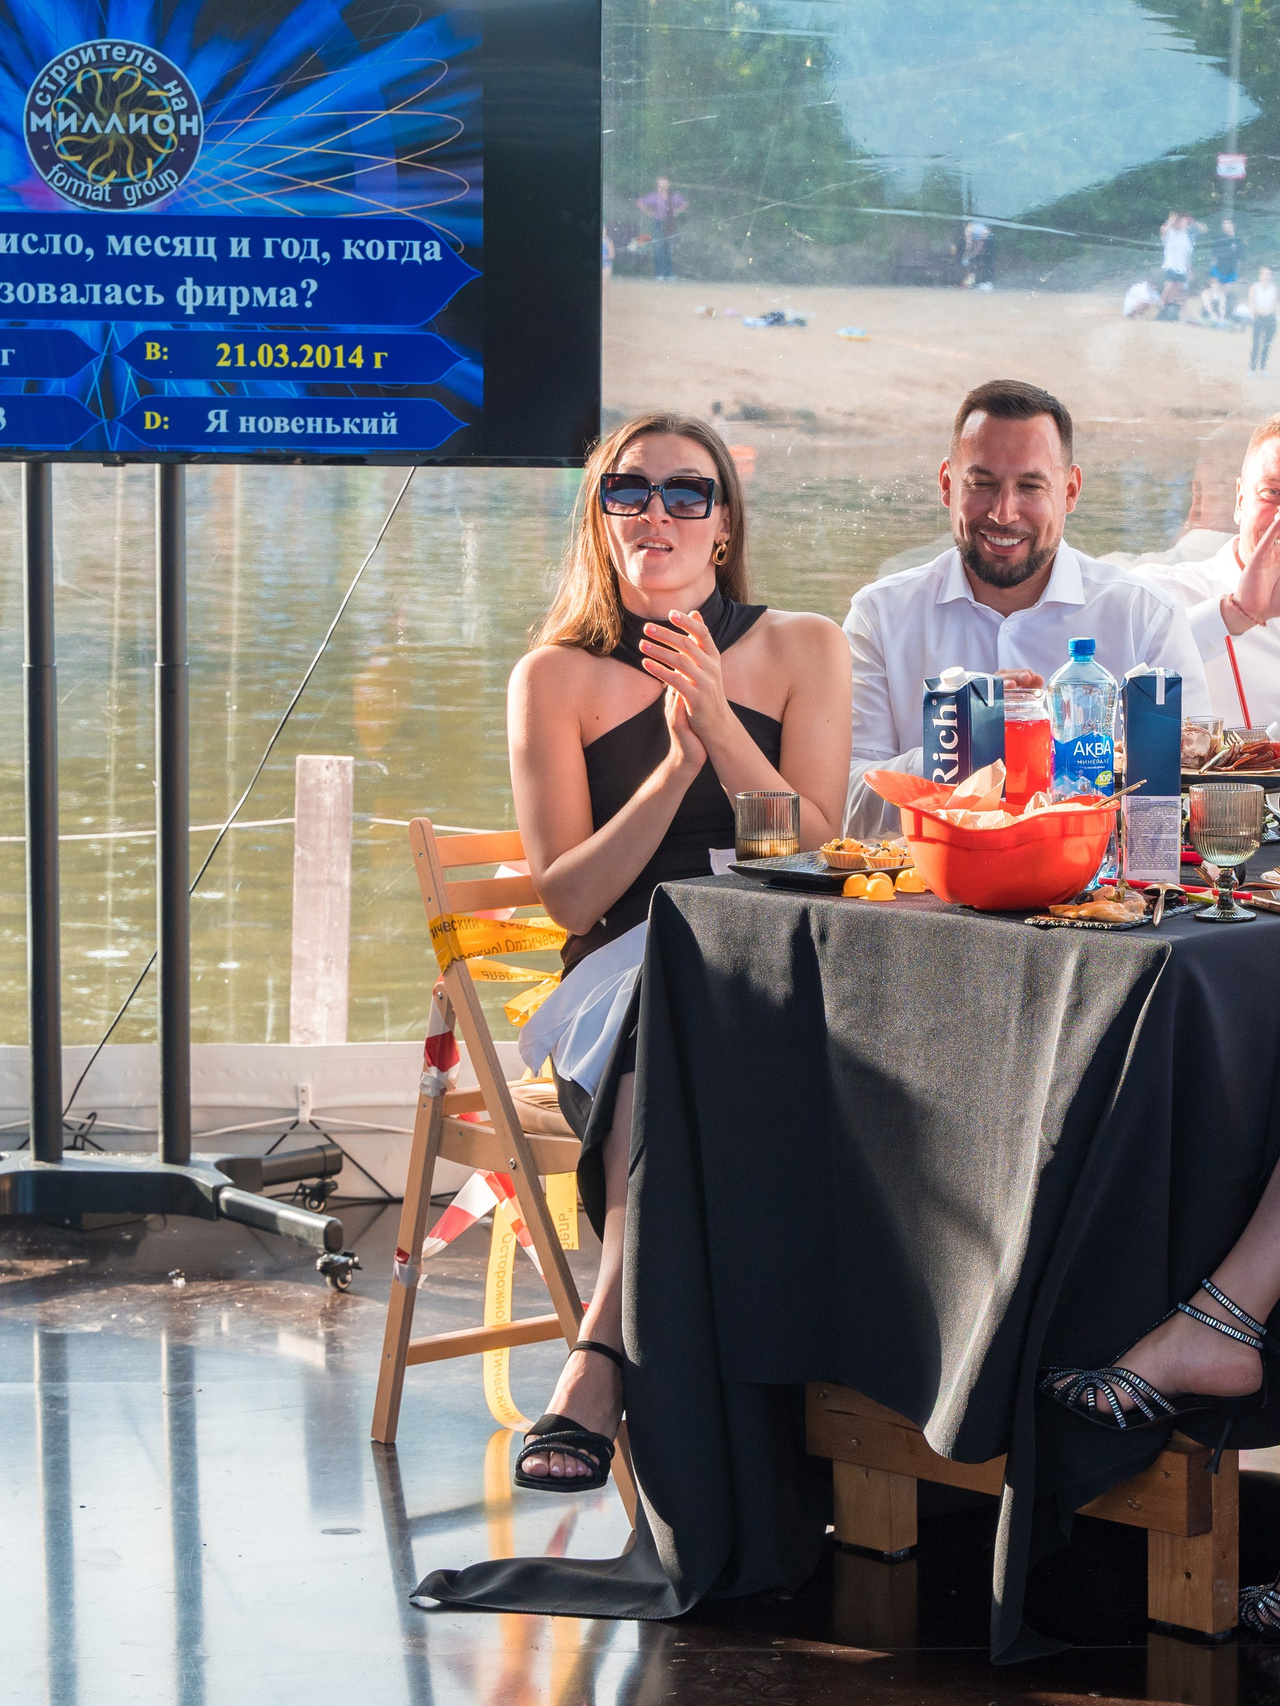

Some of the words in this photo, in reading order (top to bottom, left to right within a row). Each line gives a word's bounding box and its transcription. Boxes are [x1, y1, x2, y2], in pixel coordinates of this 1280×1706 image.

[35, 44, 158, 106] строитель
[163, 79, 189, 112] на
[46, 163, 112, 203] format
[122, 168, 179, 207] group
[0, 232, 95, 262] исло,
[106, 234, 218, 262] месяц
[228, 237, 251, 258] и
[263, 237, 331, 266] год,
[342, 238, 443, 265] когда
[0, 281, 165, 306] зовалась
[175, 276, 319, 316] фирма?
[144, 341, 169, 361] B:
[215, 342, 365, 369] 21.03.2014
[372, 352, 389, 369] г
[143, 410, 169, 430] D:
[204, 409, 230, 433] Я
[238, 411, 399, 435] новенький
[932, 703, 959, 786] Rich
[1073, 740, 1112, 758] АКВА
[505, 930, 567, 953] Оптически
[493, 1349, 519, 1421] тический
